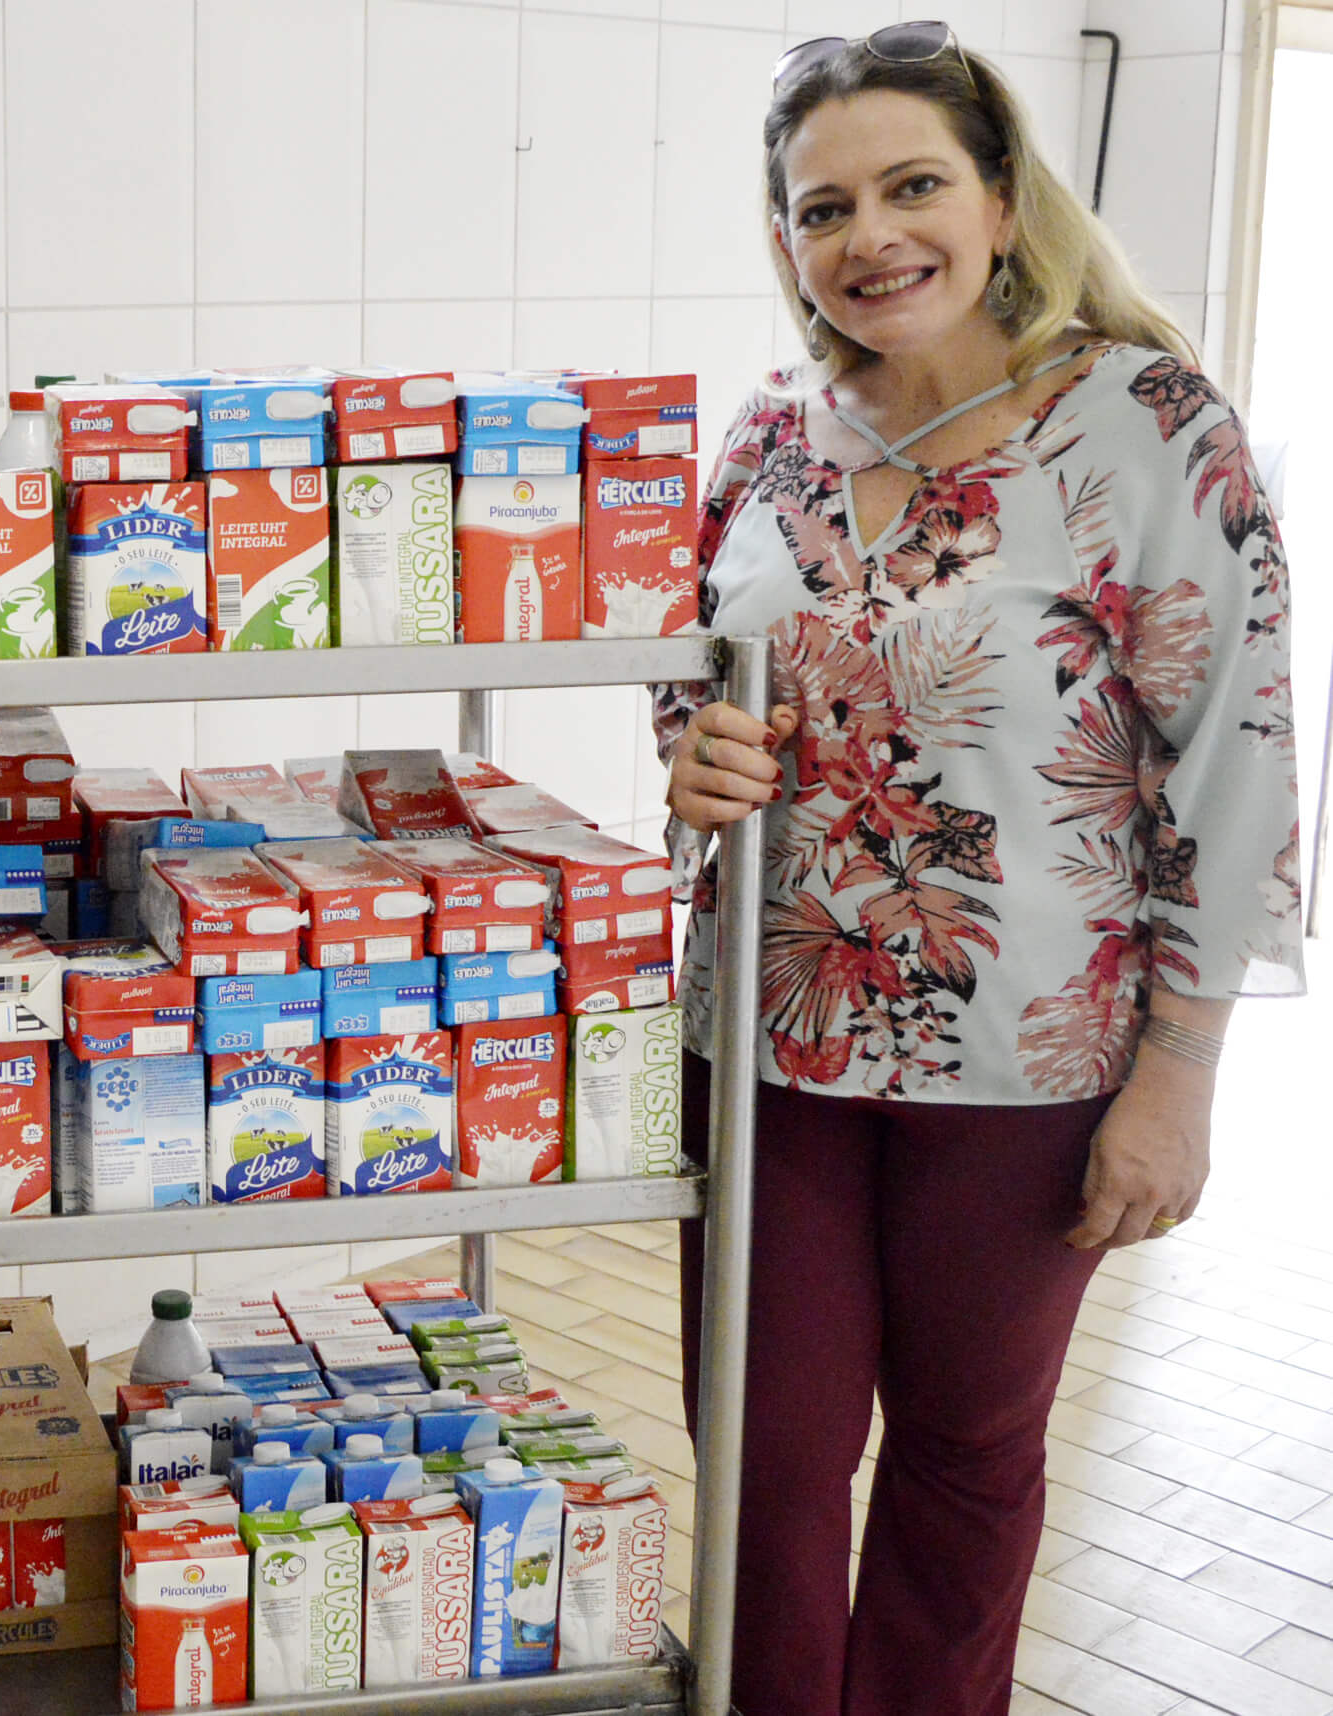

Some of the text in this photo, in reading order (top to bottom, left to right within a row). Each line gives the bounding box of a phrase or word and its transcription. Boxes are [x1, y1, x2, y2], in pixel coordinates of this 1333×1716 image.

[489, 505, 558, 520] Piracanjuba
[106, 517, 184, 541] LIDER
[219, 522, 288, 536] LEITE UHT
[613, 520, 670, 548] Integral
[221, 536, 287, 549] INTEGRAL
[411, 466, 451, 645] JUSSARA
[126, 549, 147, 562] SEU
[149, 549, 174, 563] LEITE
[397, 529, 412, 583] INTEGRAL
[399, 583, 414, 608] UHT
[515, 576, 536, 641] ntegral
[115, 608, 181, 648] Leite
[335, 966, 370, 980] Integral
[218, 981, 254, 994] Integral
[97, 1079, 139, 1099] gege
[232, 1069, 303, 1090] LIDER
[360, 1067, 432, 1087] LIDER
[484, 1073, 539, 1102] Integral
[250, 1098, 267, 1108] SEU
[268, 1098, 293, 1111] LEITE
[378, 1095, 395, 1105] SEU
[397, 1094, 421, 1107] LEITE
[629, 1070, 643, 1120] INTEGRAL
[643, 1011, 679, 1176] JUSSARA
[630, 1124, 644, 1145] UHT
[238, 1153, 300, 1190] Leite
[367, 1150, 428, 1188] Leite
[139, 1461, 205, 1484] Italac
[160, 1583, 228, 1599] Piracanjuba
[615, 1527, 632, 1657] LEITE UHT SEMIDESNATADO
[627, 1507, 667, 1661] JUSSARA
[309, 1592, 324, 1640] INTEGRAL
[324, 1538, 360, 1690] JUSSARA
[421, 1547, 436, 1680] LEITE UHT SEMIDESNATADO
[435, 1526, 471, 1680] JUSSARA
[479, 1541, 506, 1675] PAULISTA
[310, 1641, 324, 1664] UHT
